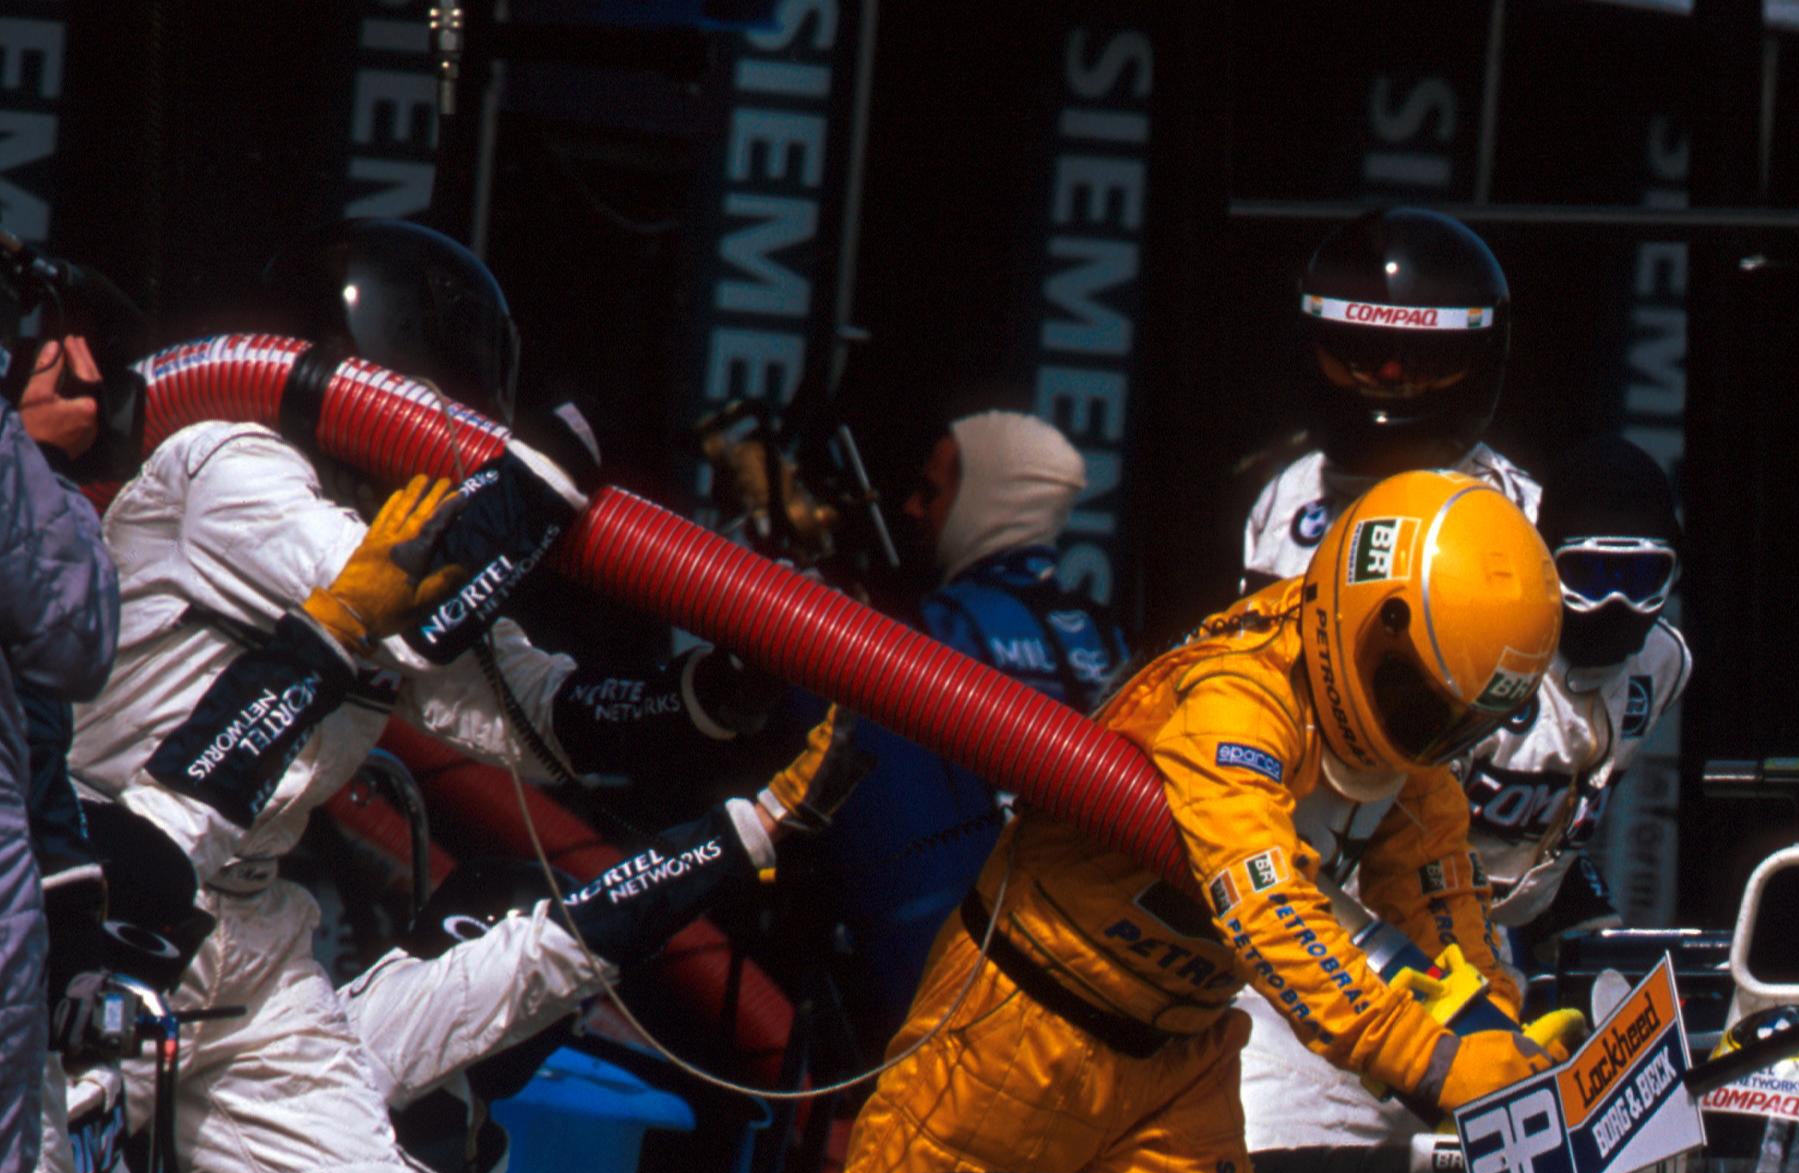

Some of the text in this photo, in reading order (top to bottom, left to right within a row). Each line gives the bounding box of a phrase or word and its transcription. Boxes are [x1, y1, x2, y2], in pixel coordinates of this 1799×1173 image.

[1345, 303, 1439, 326] COMPAQ
[1367, 524, 1396, 574] BR
[186, 687, 278, 781] NETWORKS
[607, 837, 722, 904] NETWORKS
[1254, 857, 1276, 885] BR
[1573, 991, 1661, 1107] Lockheed
[1634, 1045, 1678, 1107] BECK
[1625, 1087, 1644, 1121] &
